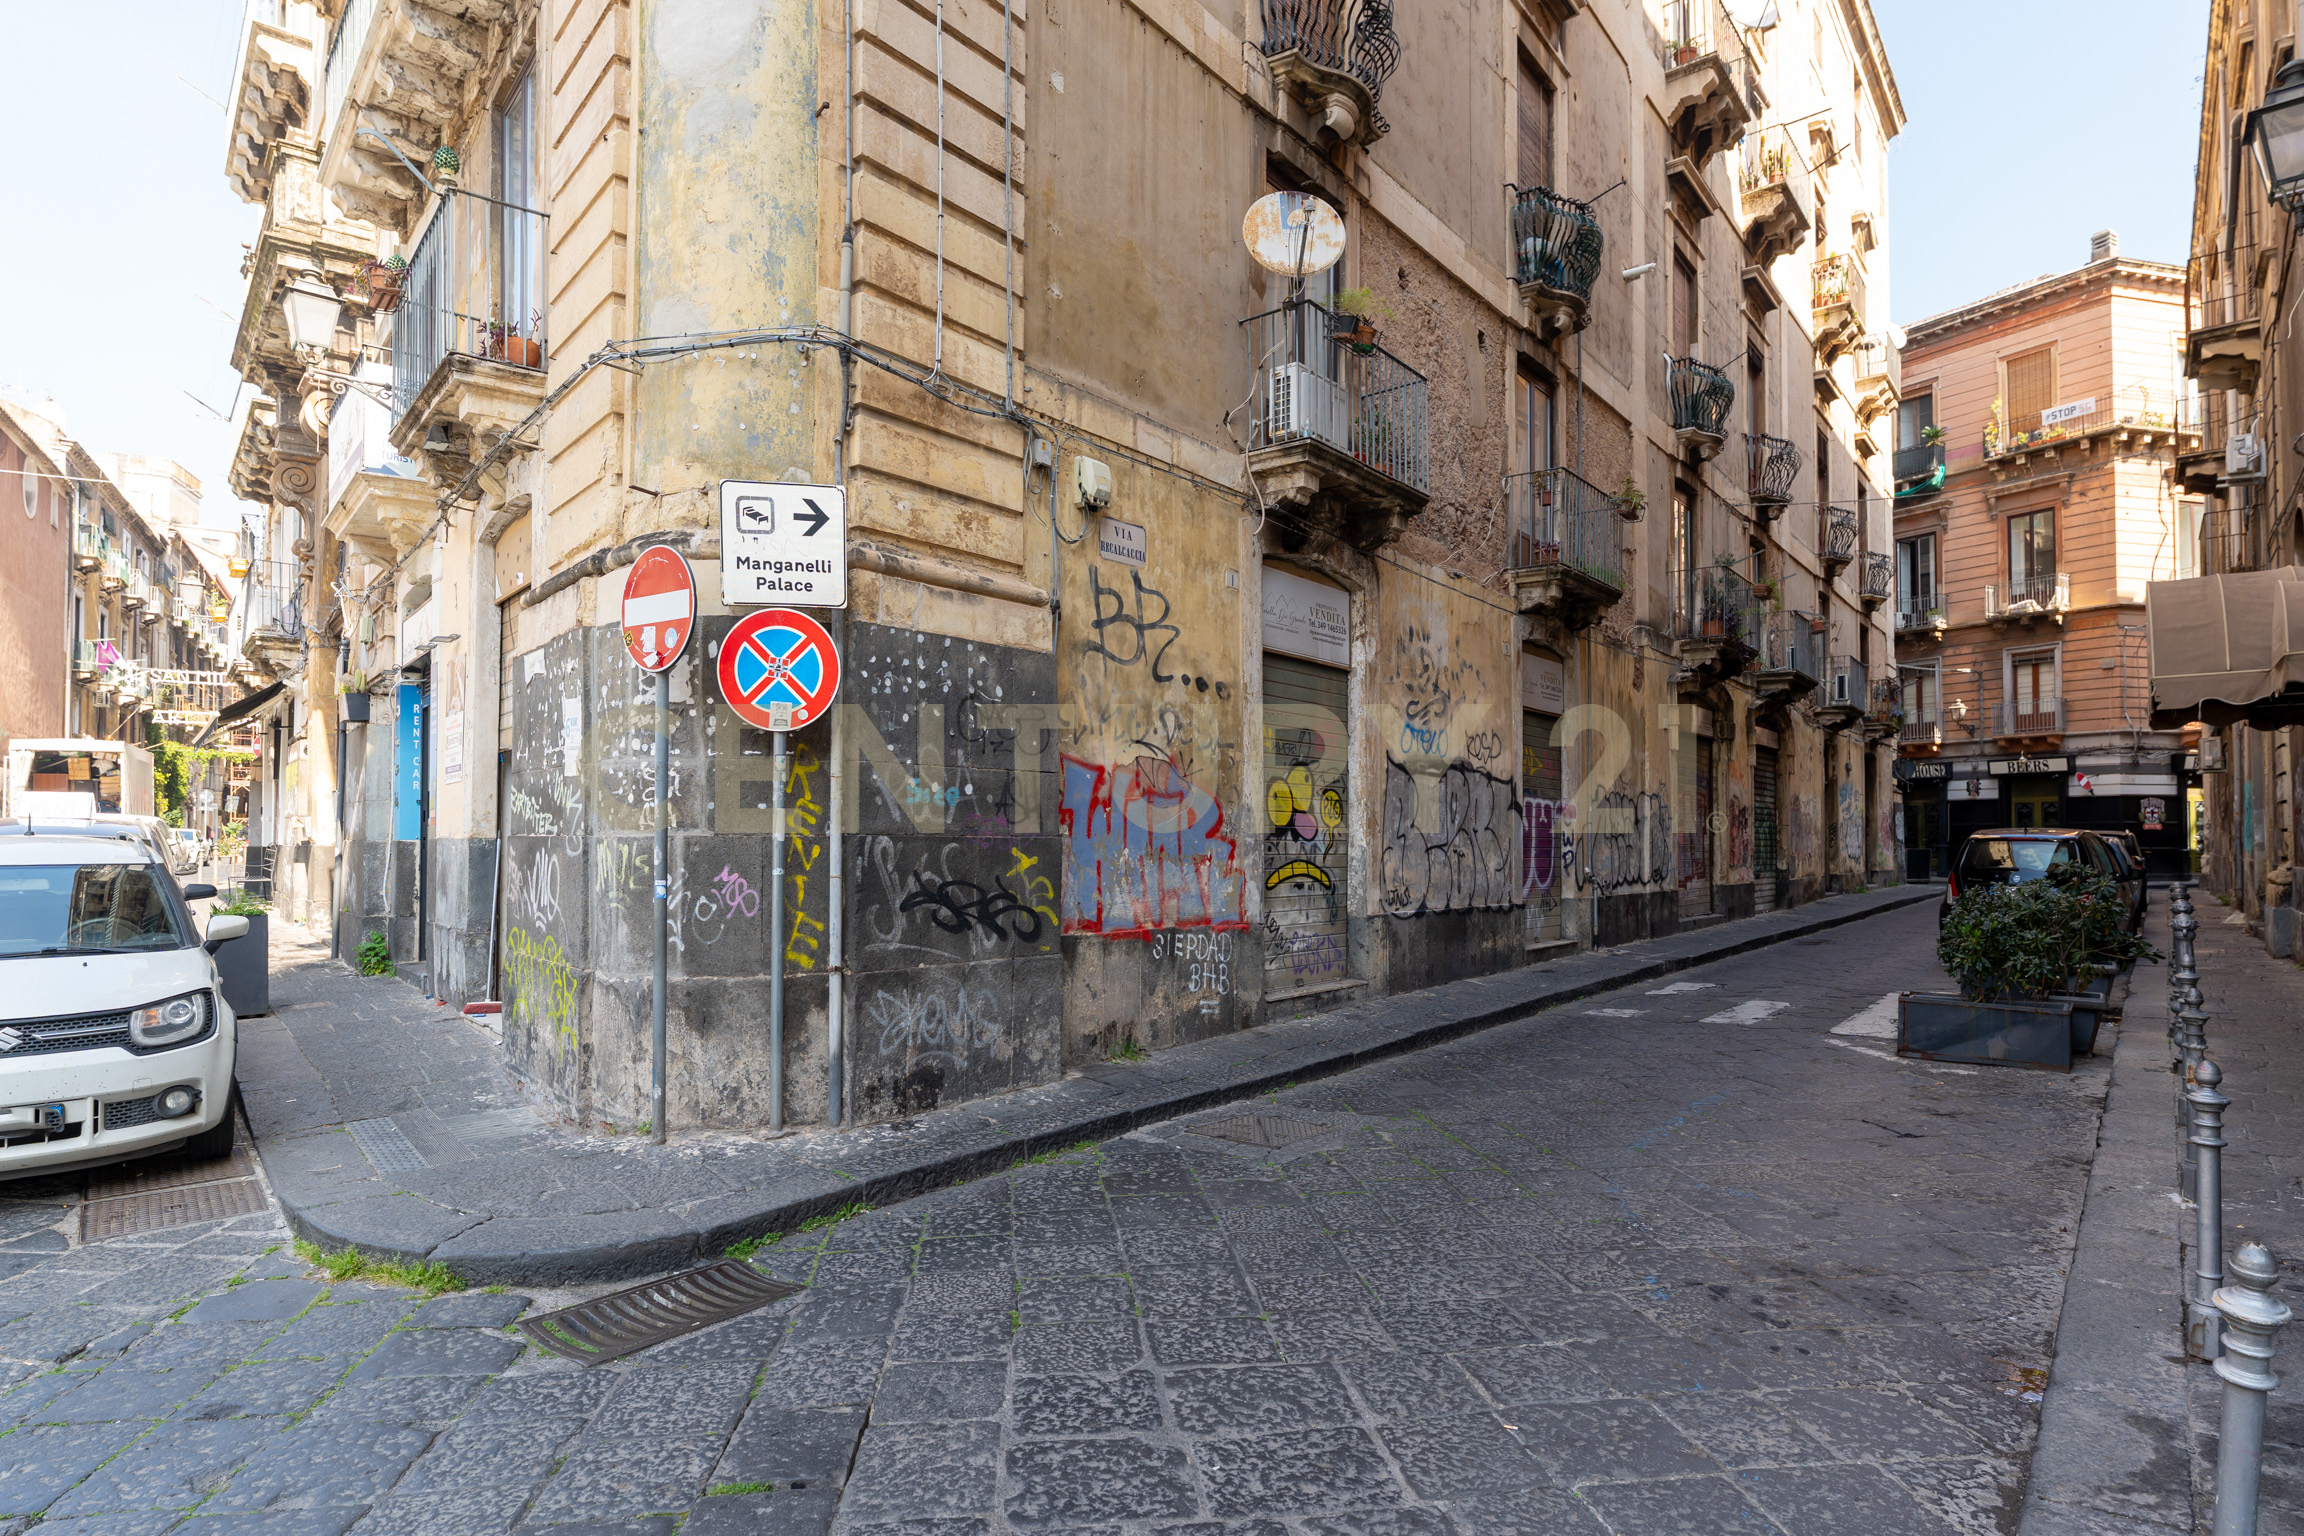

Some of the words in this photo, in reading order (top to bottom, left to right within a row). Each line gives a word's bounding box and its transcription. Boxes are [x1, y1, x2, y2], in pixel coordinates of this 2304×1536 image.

[1114, 526, 1132, 541] VIA
[736, 556, 832, 574] Manganelli
[756, 576, 813, 592] Palace
[1309, 606, 1346, 626] VENDITA
[2007, 760, 2050, 774] BEERS
